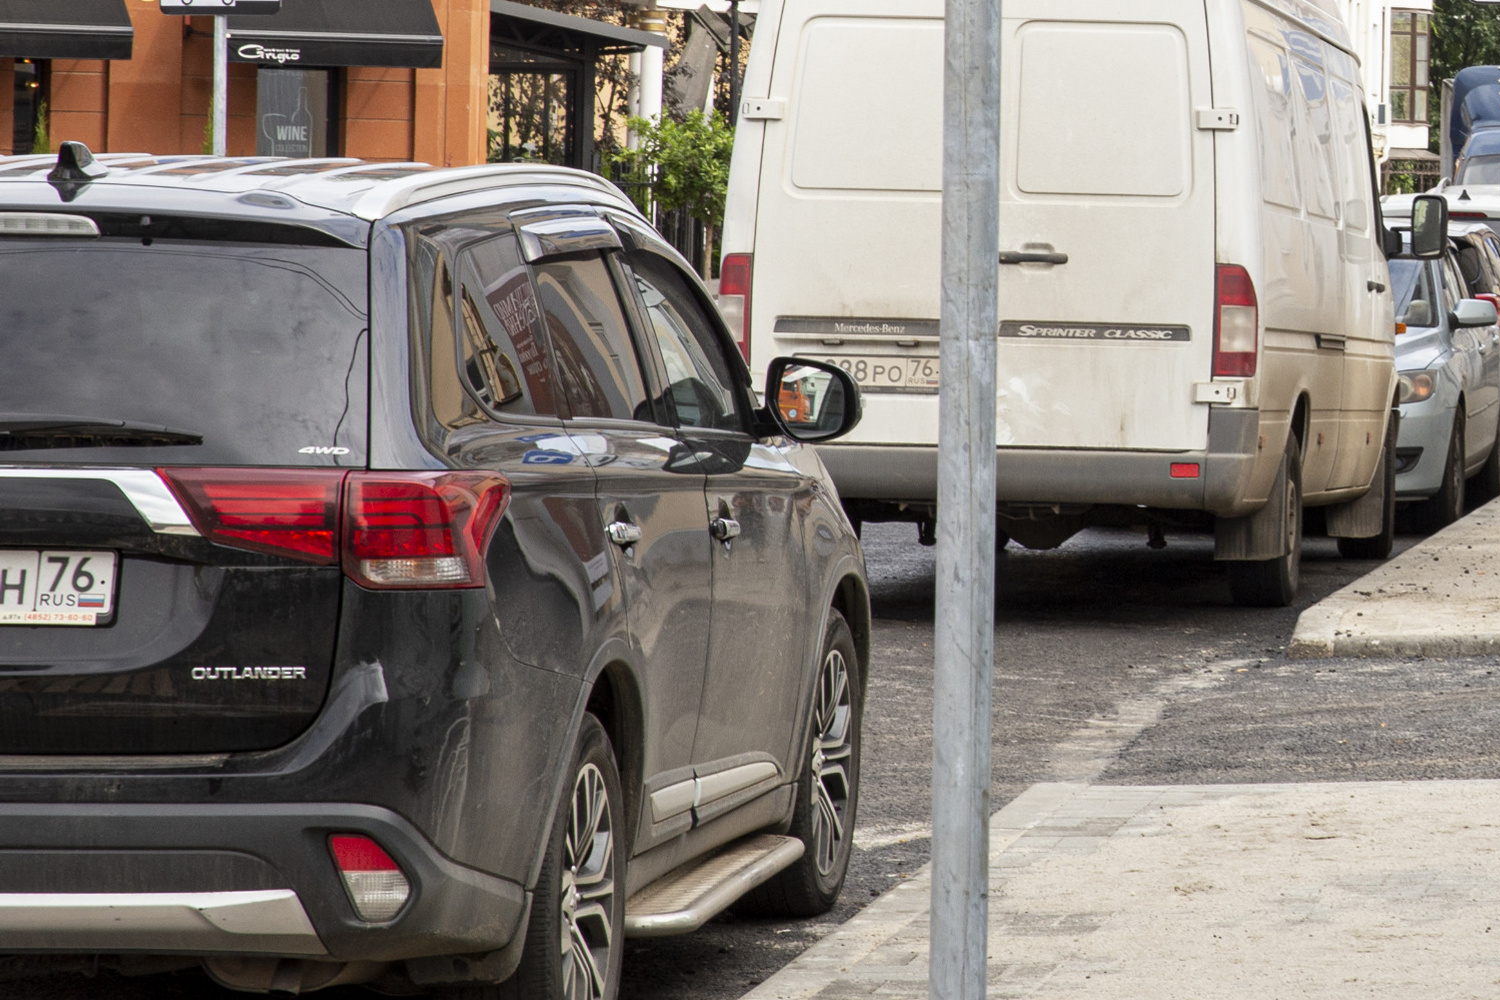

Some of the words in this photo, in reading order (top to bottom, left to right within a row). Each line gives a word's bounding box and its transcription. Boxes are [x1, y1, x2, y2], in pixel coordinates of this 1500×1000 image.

[238, 44, 300, 63] Grigio
[276, 125, 308, 141] WINE
[834, 322, 906, 334] Mercedes-Benz
[1104, 328, 1173, 340] CLASSIC
[910, 360, 933, 377] 76
[907, 377, 925, 385] RUS
[298, 446, 350, 455] 4WD
[47, 556, 95, 593] 76
[40, 593, 76, 607] RUS
[23, 613, 51, 622] (4852)
[191, 666, 306, 680] OUTLANDER
